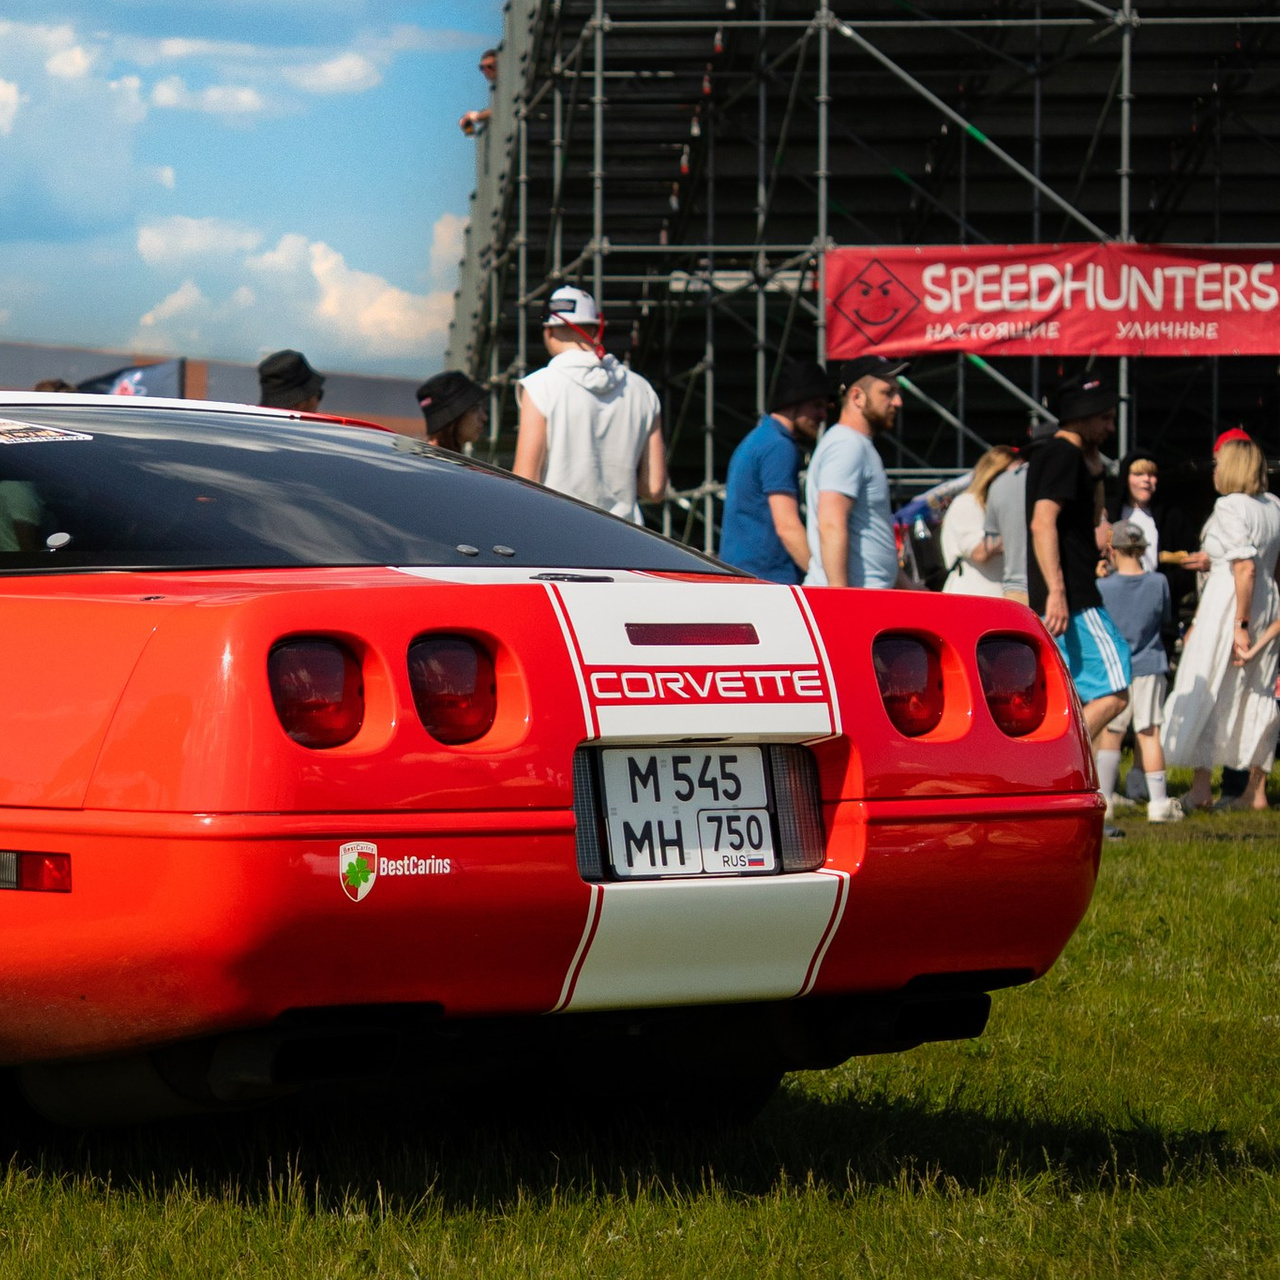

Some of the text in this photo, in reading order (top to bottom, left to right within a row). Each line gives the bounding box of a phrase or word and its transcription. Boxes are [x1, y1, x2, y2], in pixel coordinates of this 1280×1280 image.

[922, 261, 1279, 314] SPEEDHUNTERS
[925, 320, 1218, 342] НАСТОЯЩИЕ УЛИЧНЫЕ
[589, 670, 824, 699] CORVETTE
[672, 754, 742, 802] 545
[706, 814, 763, 851] 750
[380, 855, 451, 876] BestCarins
[722, 854, 747, 867] RUS
